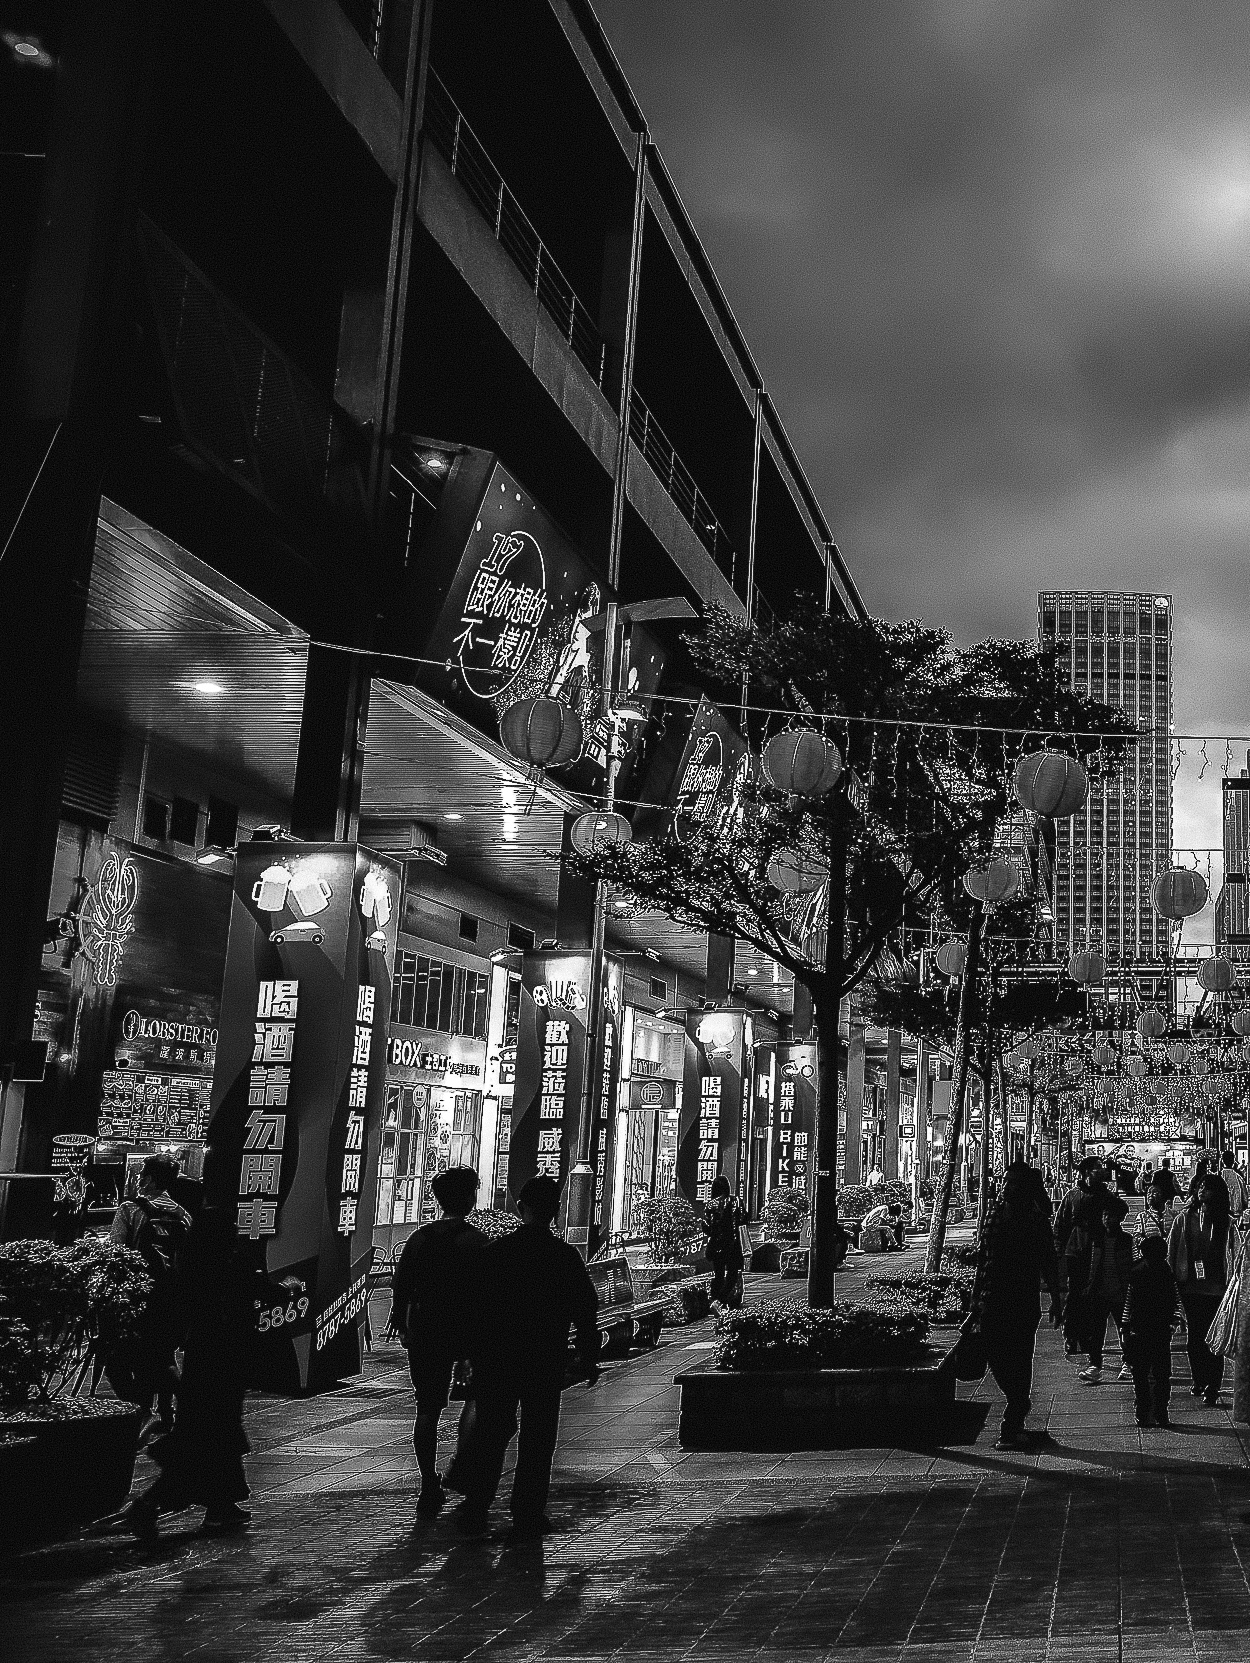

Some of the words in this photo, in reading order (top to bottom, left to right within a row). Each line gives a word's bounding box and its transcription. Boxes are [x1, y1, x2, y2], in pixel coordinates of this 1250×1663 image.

[480, 533, 524, 575] 17
[464, 569, 547, 628] 跟你想的
[393, 1038, 422, 1067] BOX
[540, 1020, 570, 1119] 歡迎蒞臨
[237, 979, 299, 1239] 喝酒請勿開車
[338, 985, 376, 1236] 喝酒請勿開車
[696, 1076, 722, 1201] 喝酒請勿開車
[316, 1287, 367, 1351] 8787-5869
